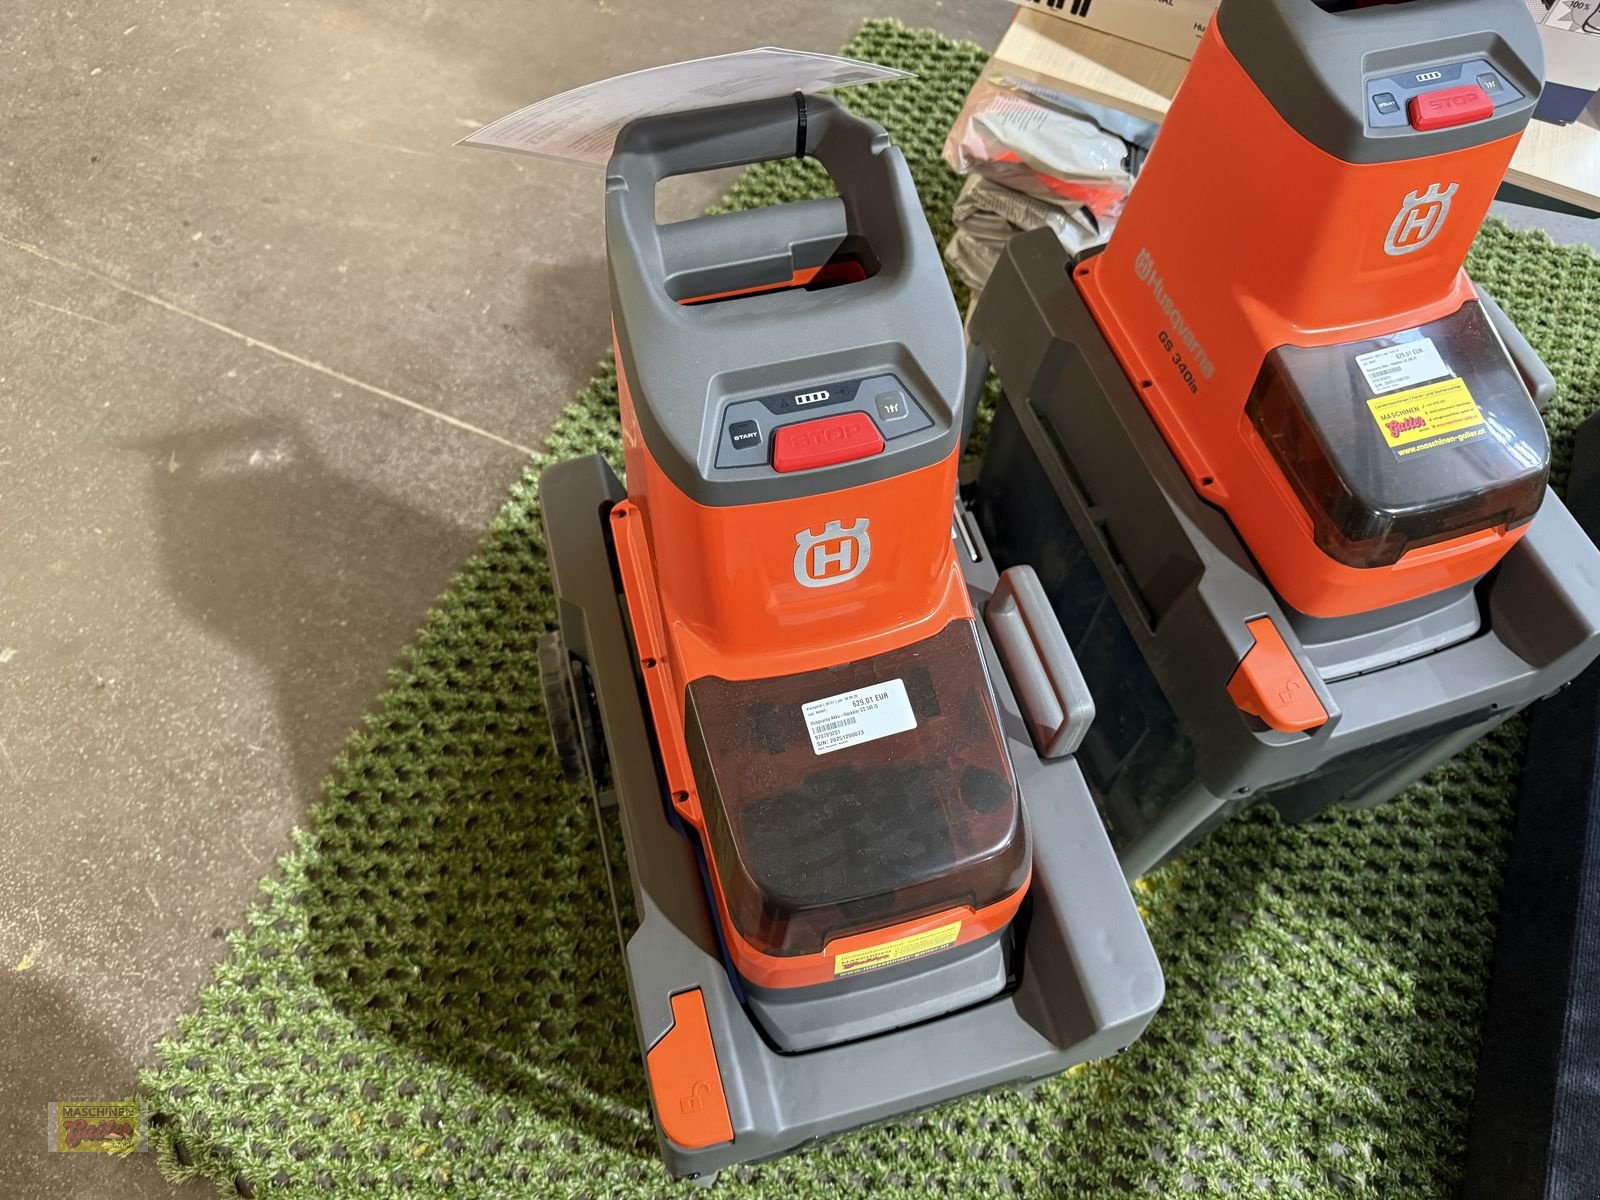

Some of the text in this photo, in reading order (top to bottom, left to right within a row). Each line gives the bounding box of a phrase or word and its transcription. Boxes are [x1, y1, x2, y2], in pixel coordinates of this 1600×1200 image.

[1428, 92, 1479, 111] STOP
[1147, 269, 1215, 381] Husqvarna
[1158, 330, 1174, 353] GS
[1380, 406, 1421, 421] MASCHINEN
[733, 431, 758, 441] START
[789, 422, 861, 449] STOP
[851, 696, 874, 709] 629,01
[875, 691, 889, 703] EUR
[816, 739, 829, 747] S/N:
